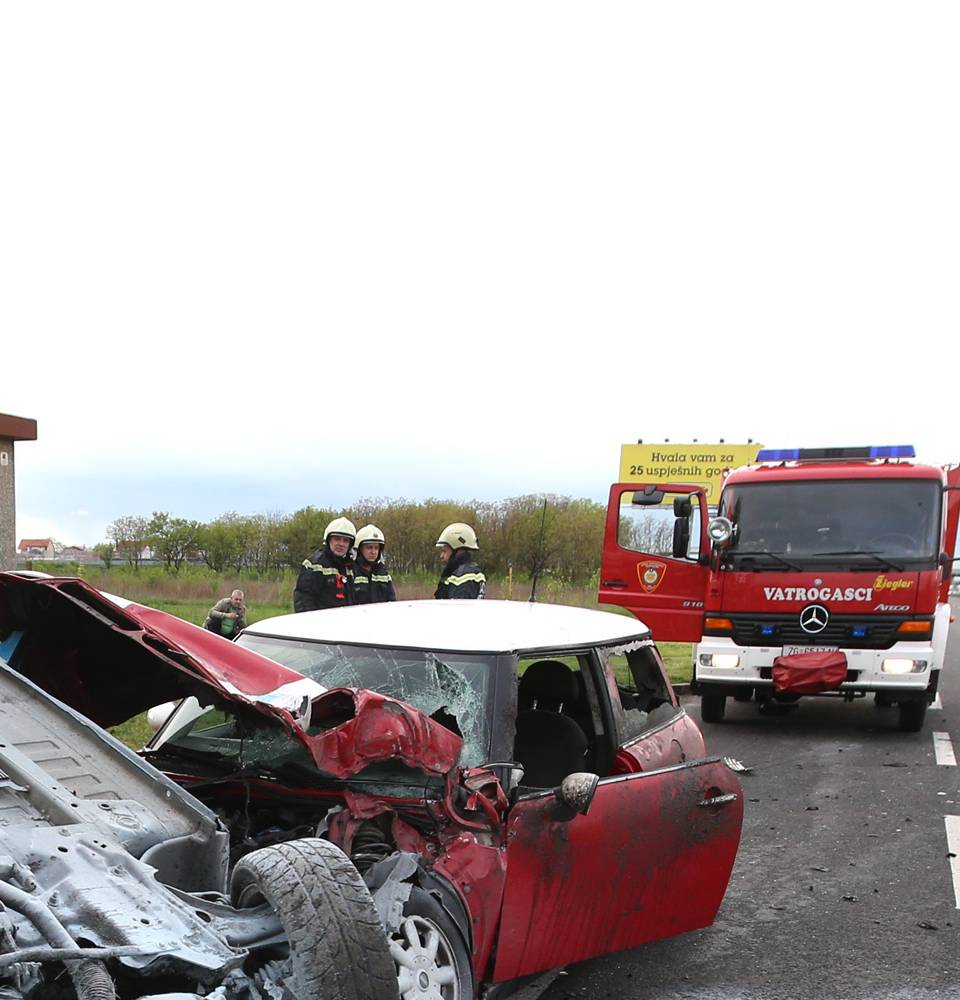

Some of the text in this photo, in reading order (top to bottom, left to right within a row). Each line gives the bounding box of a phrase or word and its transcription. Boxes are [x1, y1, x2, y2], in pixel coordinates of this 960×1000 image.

[651, 452, 734, 462] Hvala vam za
[630, 465, 644, 475] 25
[646, 465, 701, 477] uspješnih
[764, 587, 873, 601] VATROGASCI
